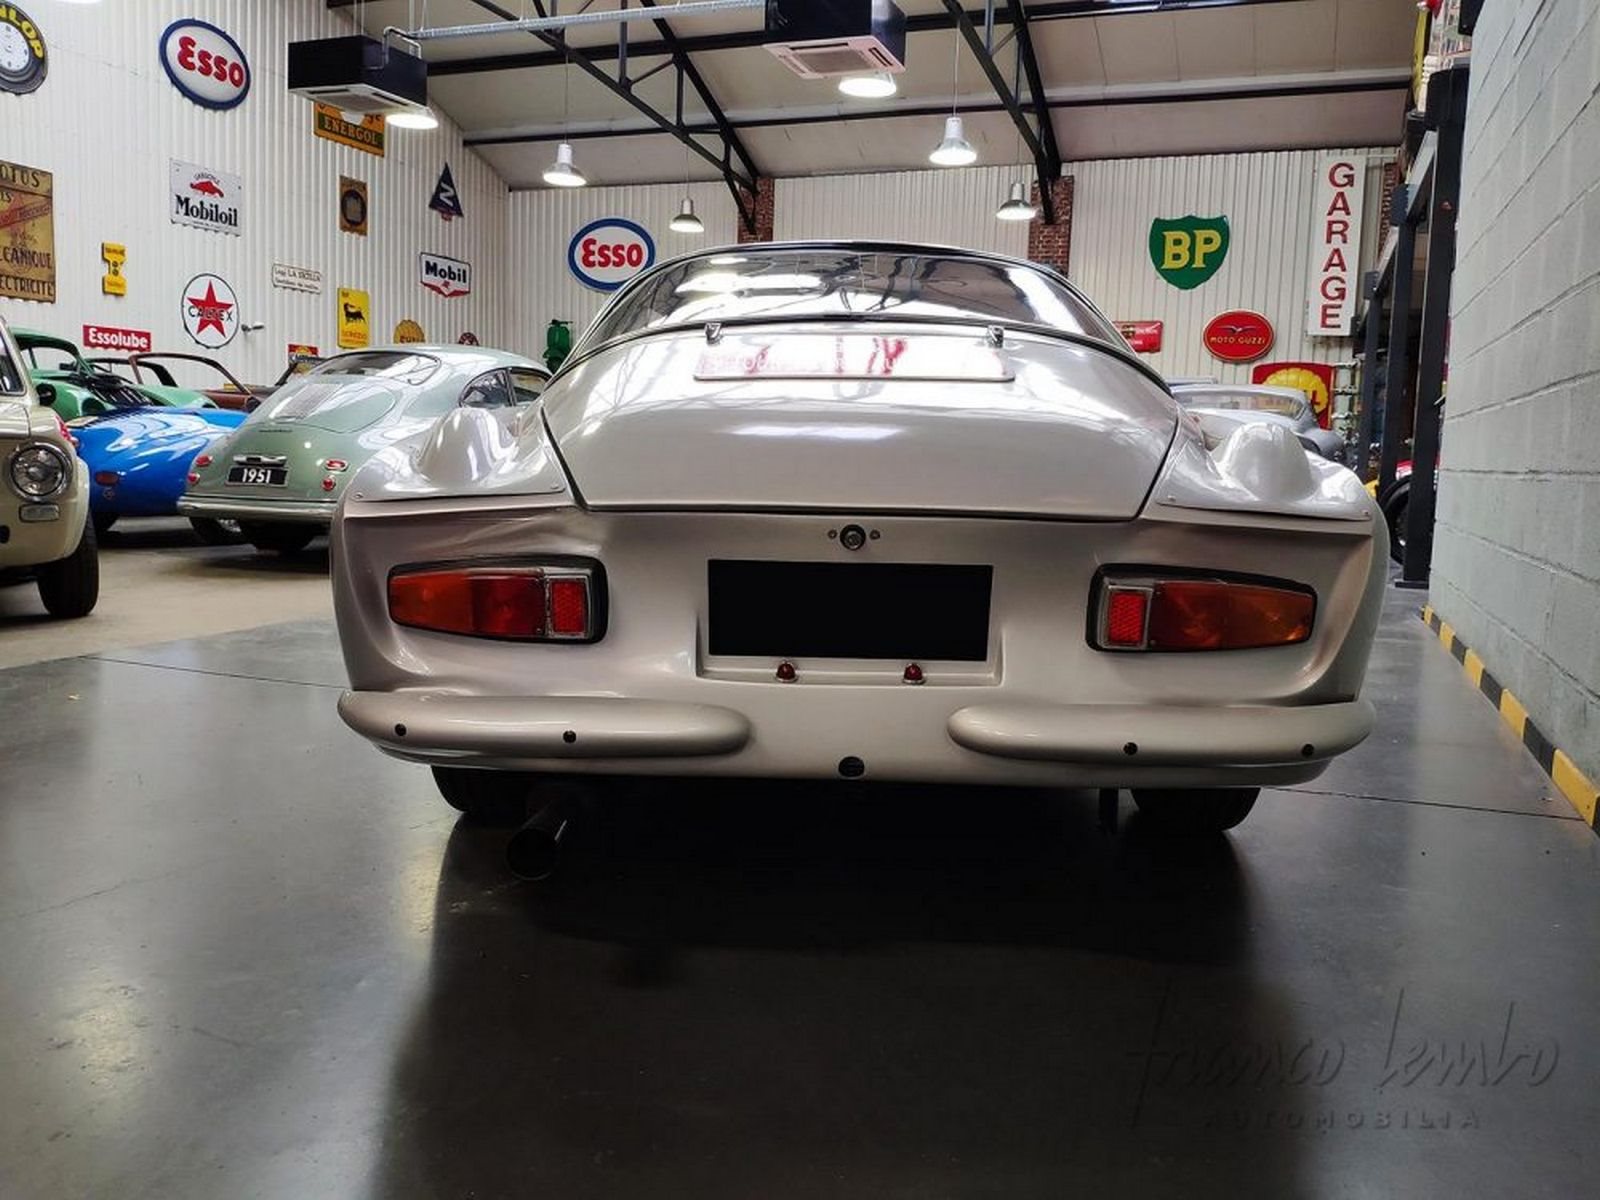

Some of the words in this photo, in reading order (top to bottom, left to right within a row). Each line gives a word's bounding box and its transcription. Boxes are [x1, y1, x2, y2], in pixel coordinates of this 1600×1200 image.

[324, 116, 378, 145] ENERGOL
[175, 194, 238, 227] Mobiloil
[581, 238, 643, 269] Esso
[1161, 229, 1222, 270] BP
[1319, 162, 1355, 329] GARAGE
[425, 260, 467, 284] Mobil
[88, 327, 149, 348] Essolube
[1210, 336, 1235, 344] MOTO
[1237, 336, 1266, 345] GUZZI
[242, 468, 272, 484] 1951
